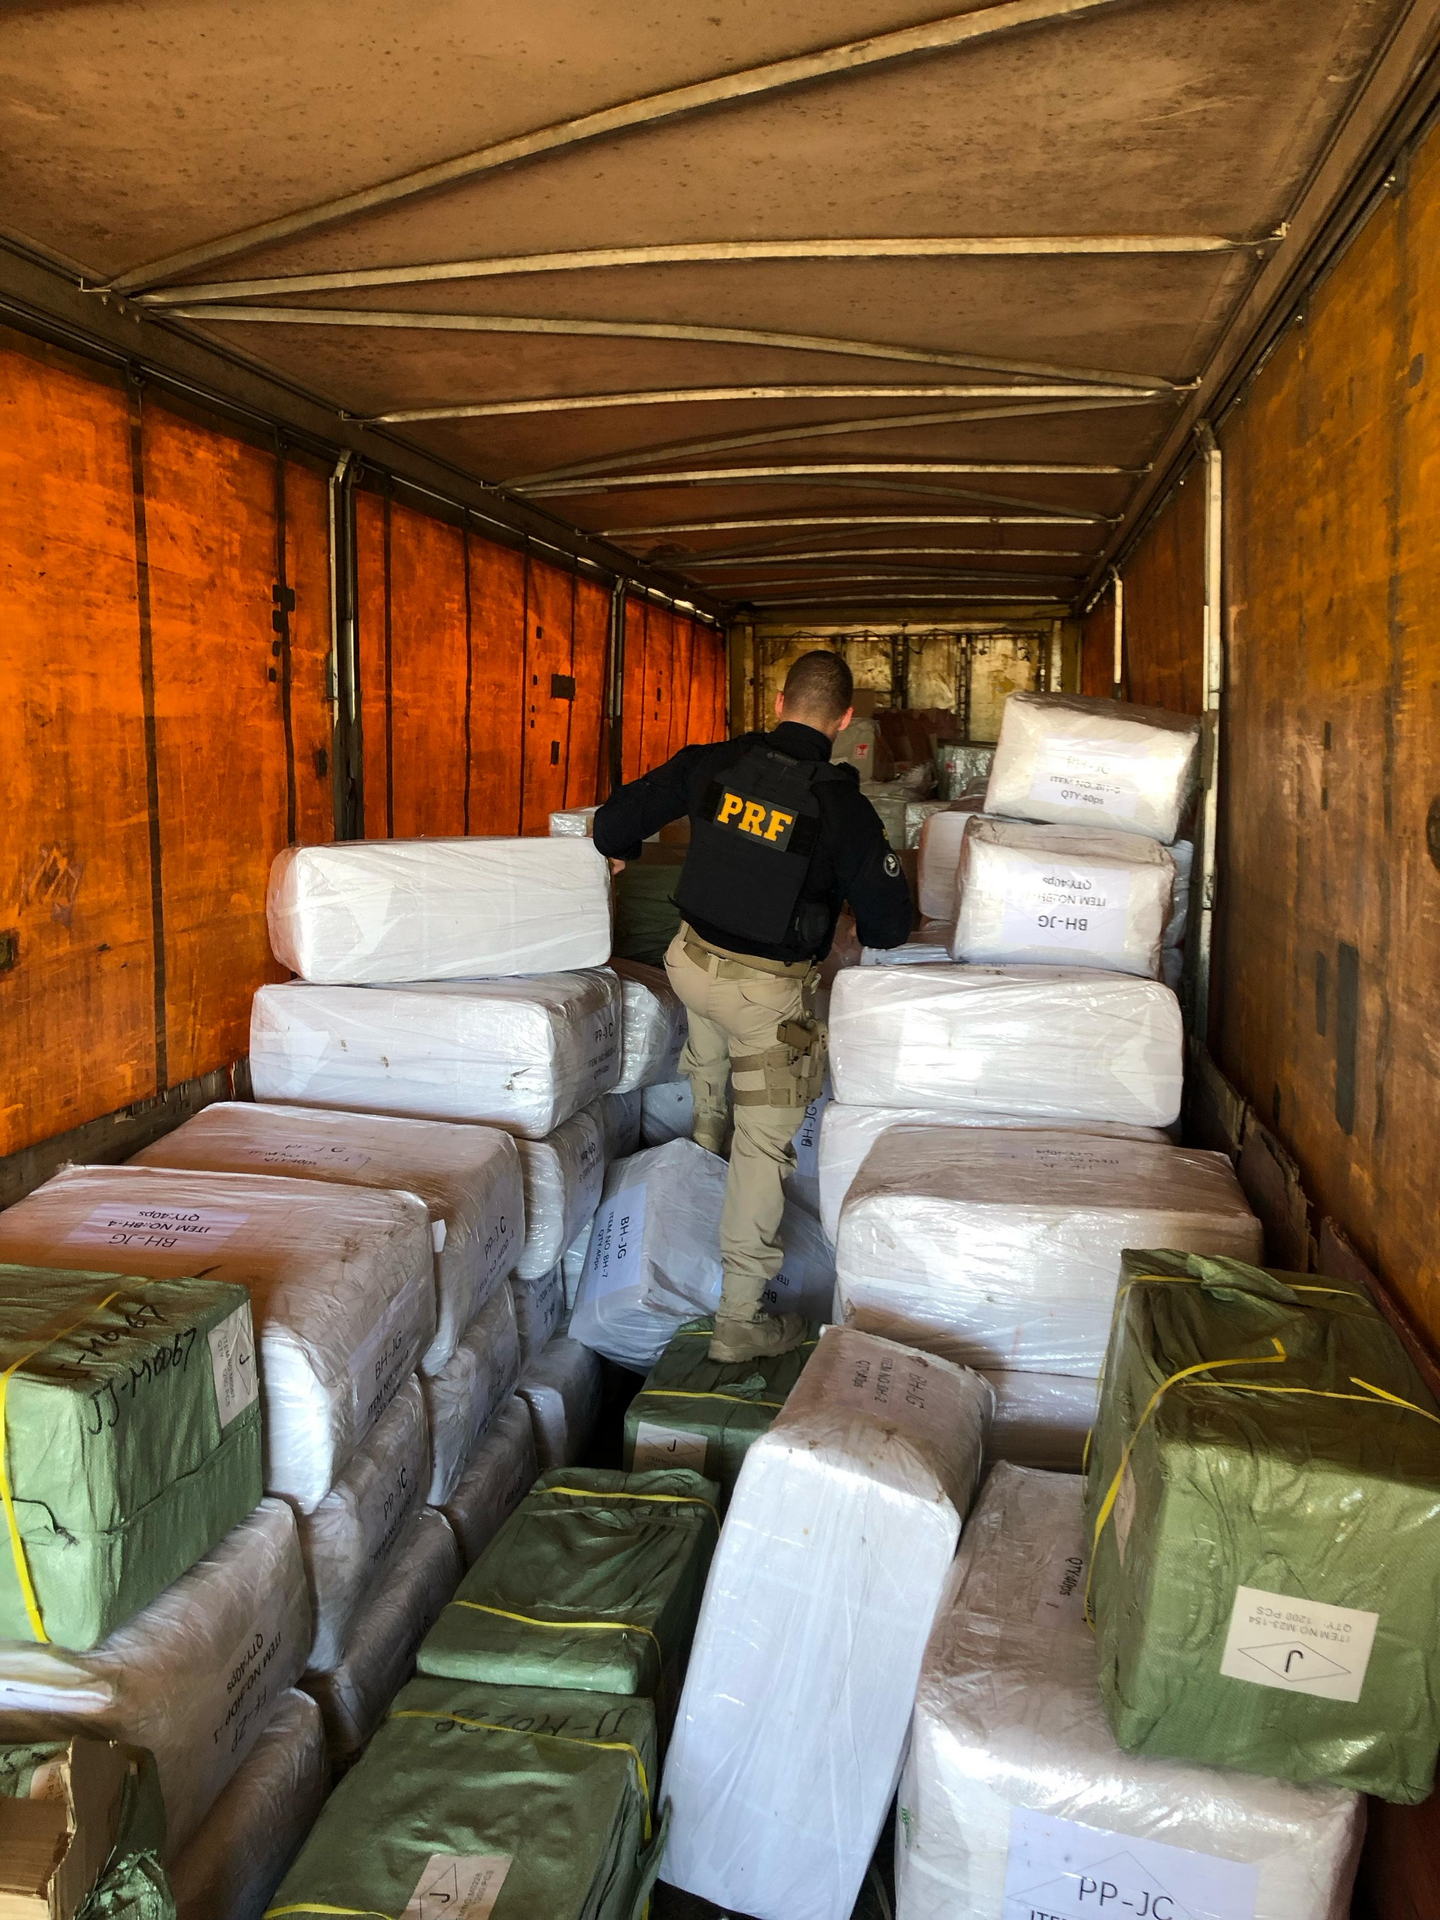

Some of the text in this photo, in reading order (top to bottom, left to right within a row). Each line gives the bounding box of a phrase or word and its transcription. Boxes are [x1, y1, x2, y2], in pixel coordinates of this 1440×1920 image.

[1061, 789, 1104, 805] QTY:40ps
[717, 792, 793, 841] PRF
[1042, 877, 1092, 890] QTY:40ps
[1079, 895, 1106, 907] ITEM
[1038, 915, 1088, 931] BH-JG
[801, 1106, 818, 1148] BH-JG
[139, 1210, 200, 1222] QTY:40ps
[606, 1211, 615, 1234] ITEM
[175, 1224, 211, 1234] ITEM
[617, 1215, 630, 1260] BH-JG
[108, 1233, 178, 1249] BH-JG
[594, 1229, 604, 1271] QTY:40ps
[239, 1353, 251, 1366] J
[375, 1331, 402, 1380] BH-JG
[880, 1356, 894, 1373] ITEM
[905, 1372, 928, 1409] BH-JG
[667, 1438, 677, 1452] J
[1058, 1556, 1083, 1596] QTY:40ps
[1256, 1606, 1282, 1619] PCS
[1285, 1613, 1312, 1625] 1200
[263, 1631, 281, 1667] ITEM
[226, 1633, 264, 1694] QTY:40ps
[1285, 1649, 1304, 1673] J
[231, 1684, 267, 1753] FF-ZP
[481, 1870, 494, 1887] PCS
[429, 1892, 451, 1904] J
[1078, 1876, 1175, 1920] PP-JC
